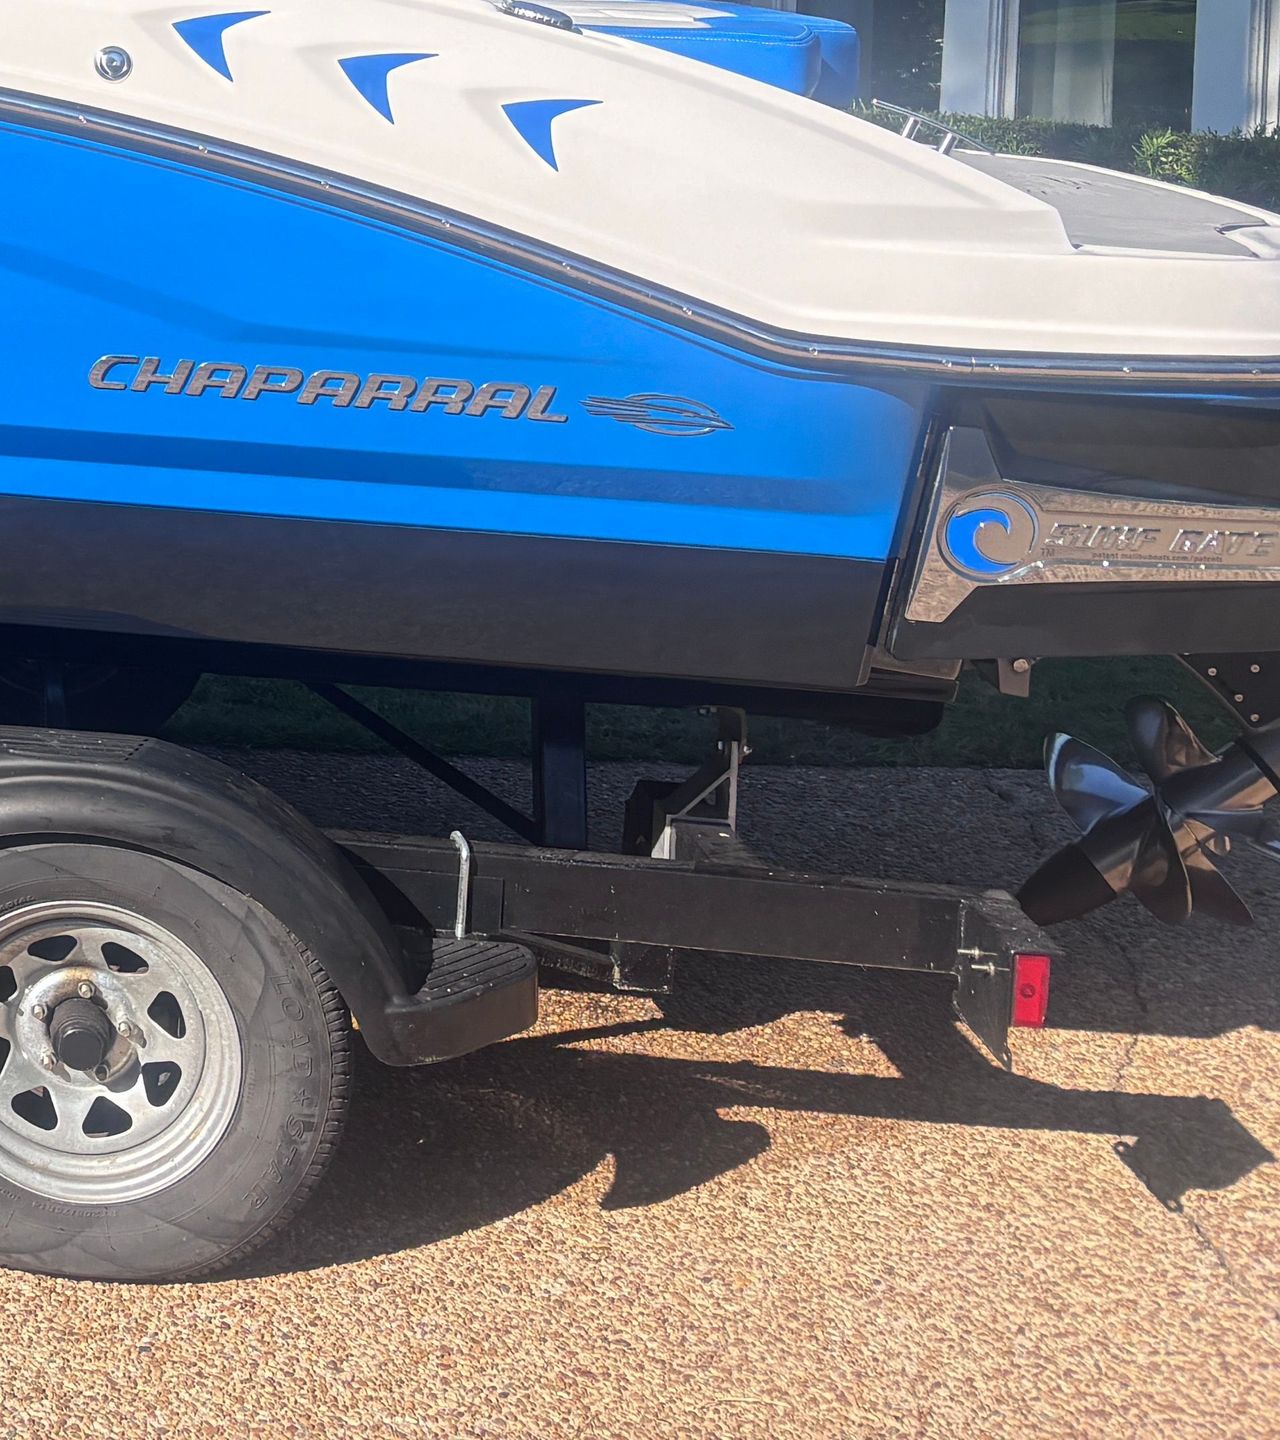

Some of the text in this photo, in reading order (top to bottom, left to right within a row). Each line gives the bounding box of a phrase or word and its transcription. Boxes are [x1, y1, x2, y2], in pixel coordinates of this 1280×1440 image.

[86, 352, 570, 424] CHAPARRAL
[1044, 522, 1279, 558] SURF GATE
